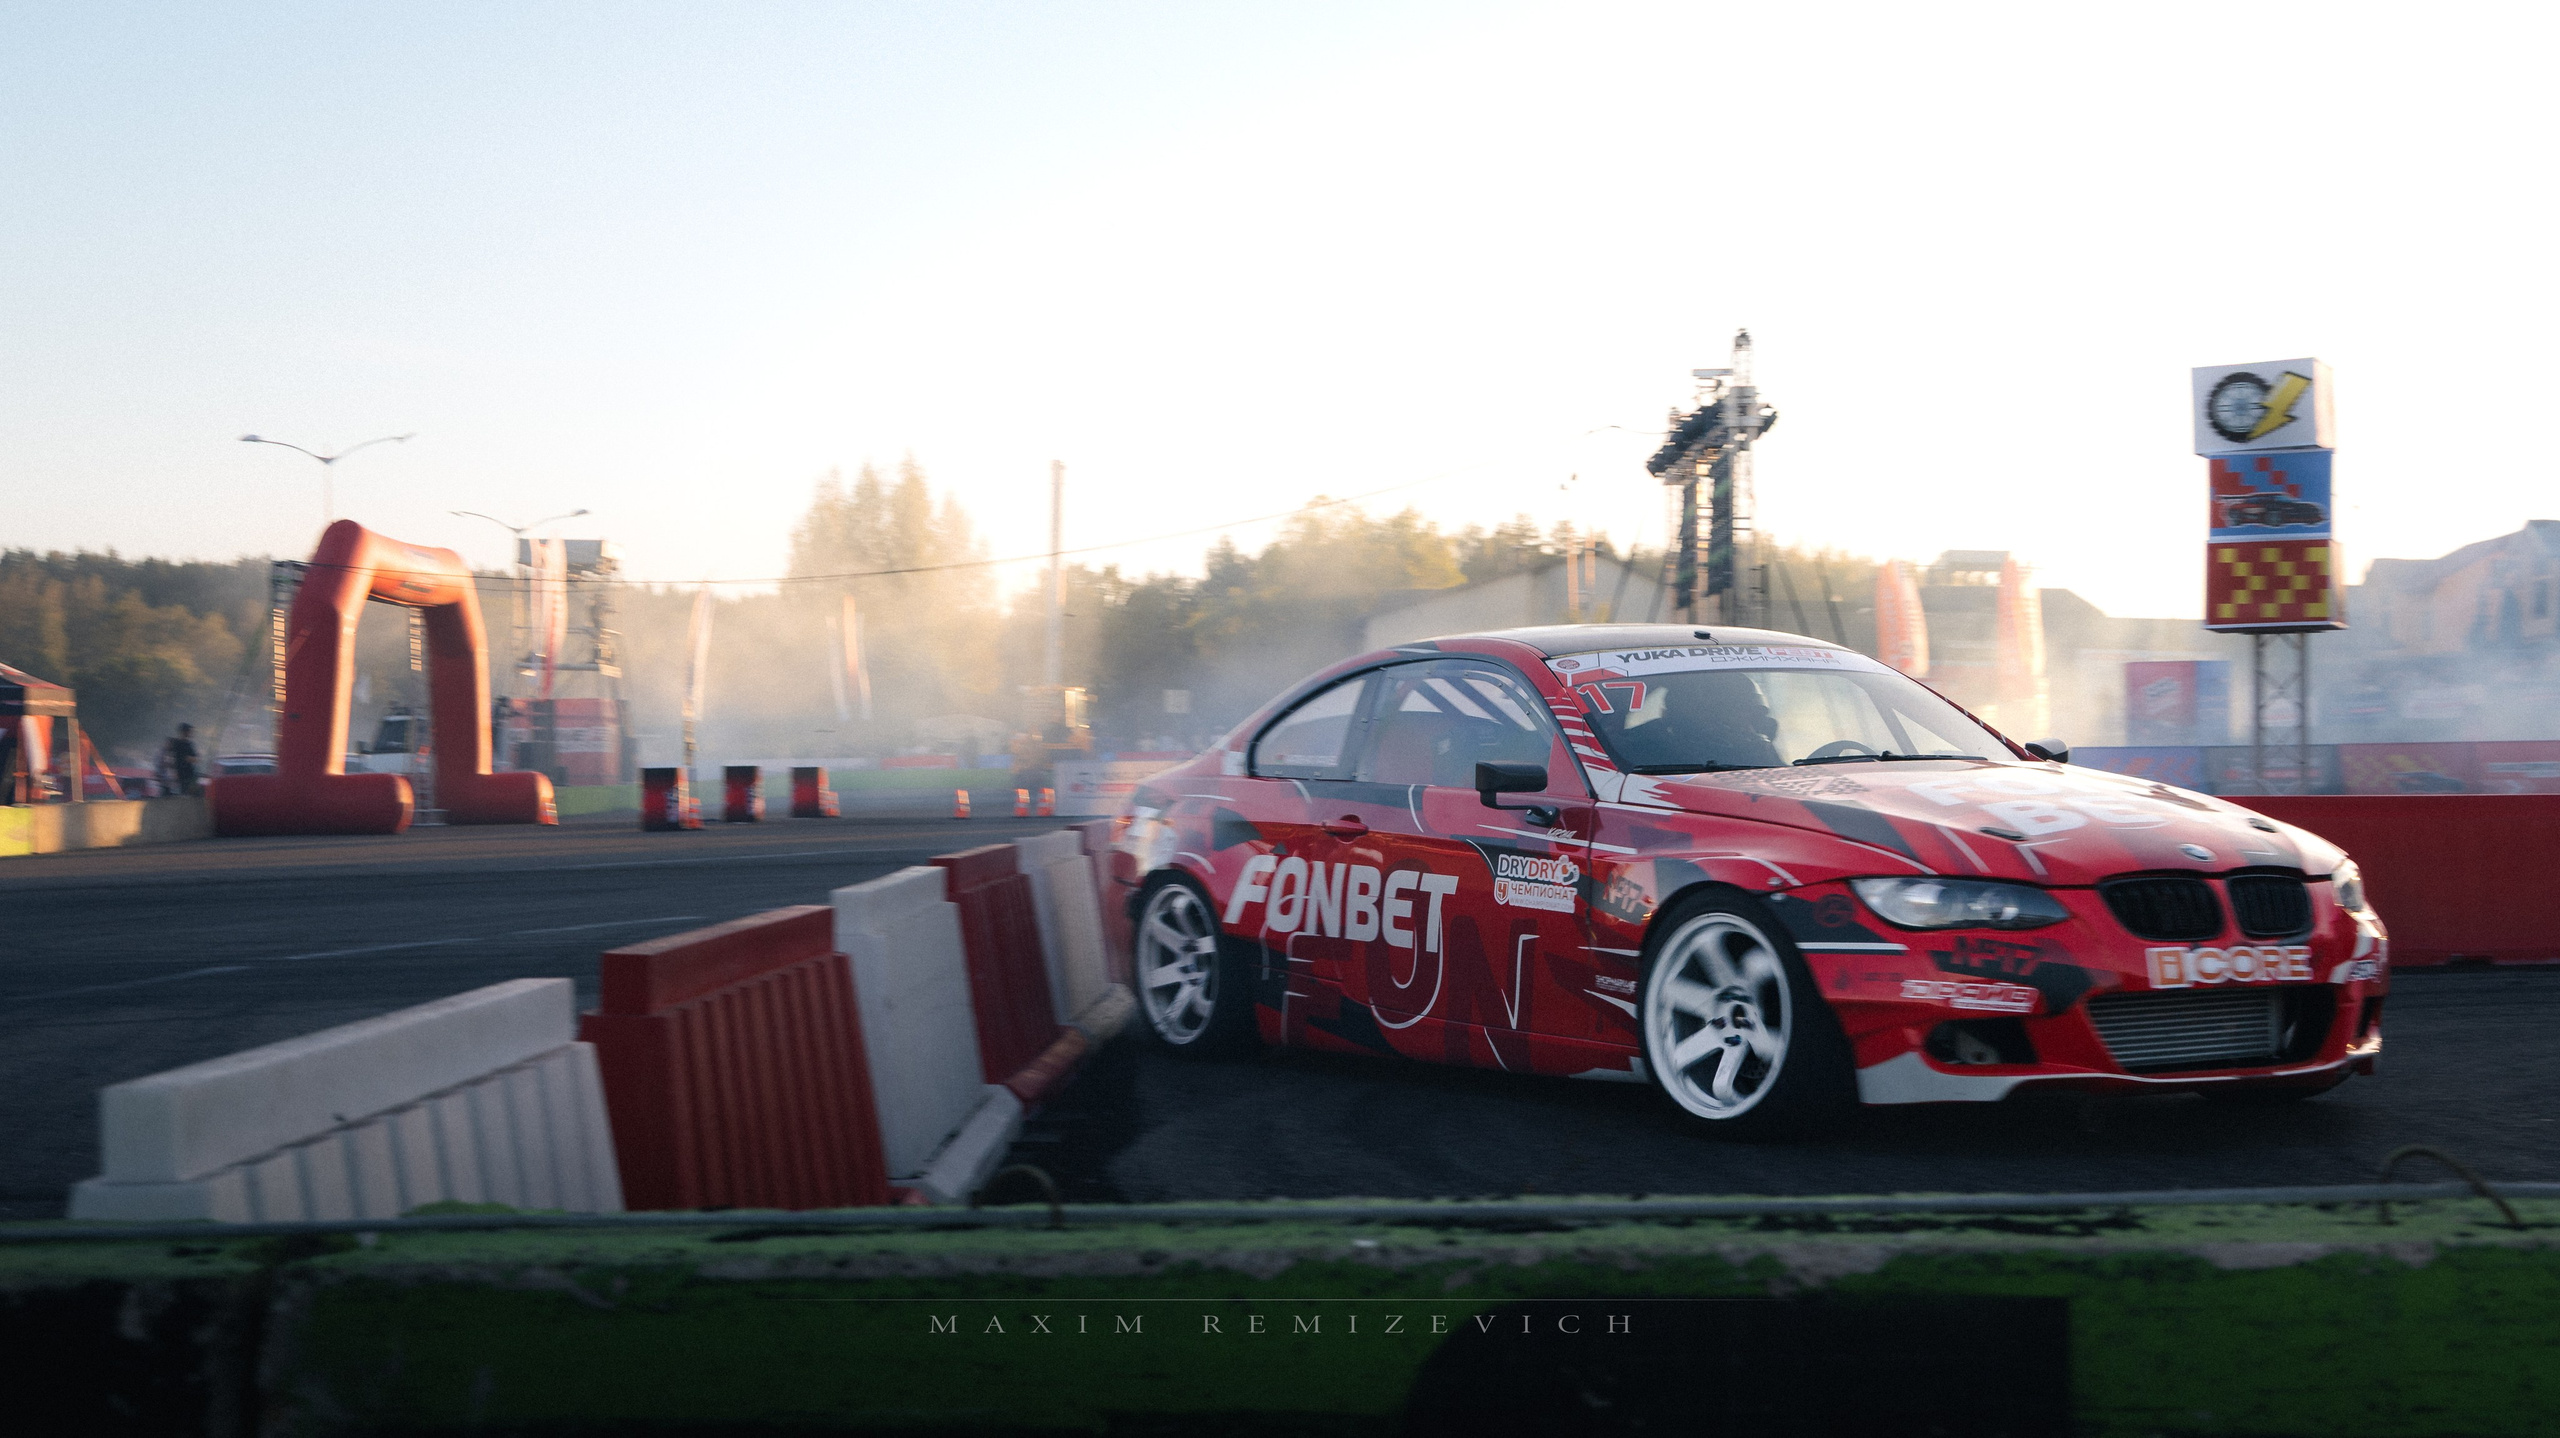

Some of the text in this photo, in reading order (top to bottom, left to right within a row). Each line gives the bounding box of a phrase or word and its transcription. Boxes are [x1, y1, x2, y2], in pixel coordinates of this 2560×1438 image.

[1616, 648, 1686, 663] YUKA
[1688, 646, 1763, 658] DRIVE
[1576, 680, 1647, 714] 17
[1499, 856, 1559, 880] DRYDRY
[1510, 882, 1576, 901] ЧЕМПИОНАТ
[1222, 854, 1460, 954] FONBET
